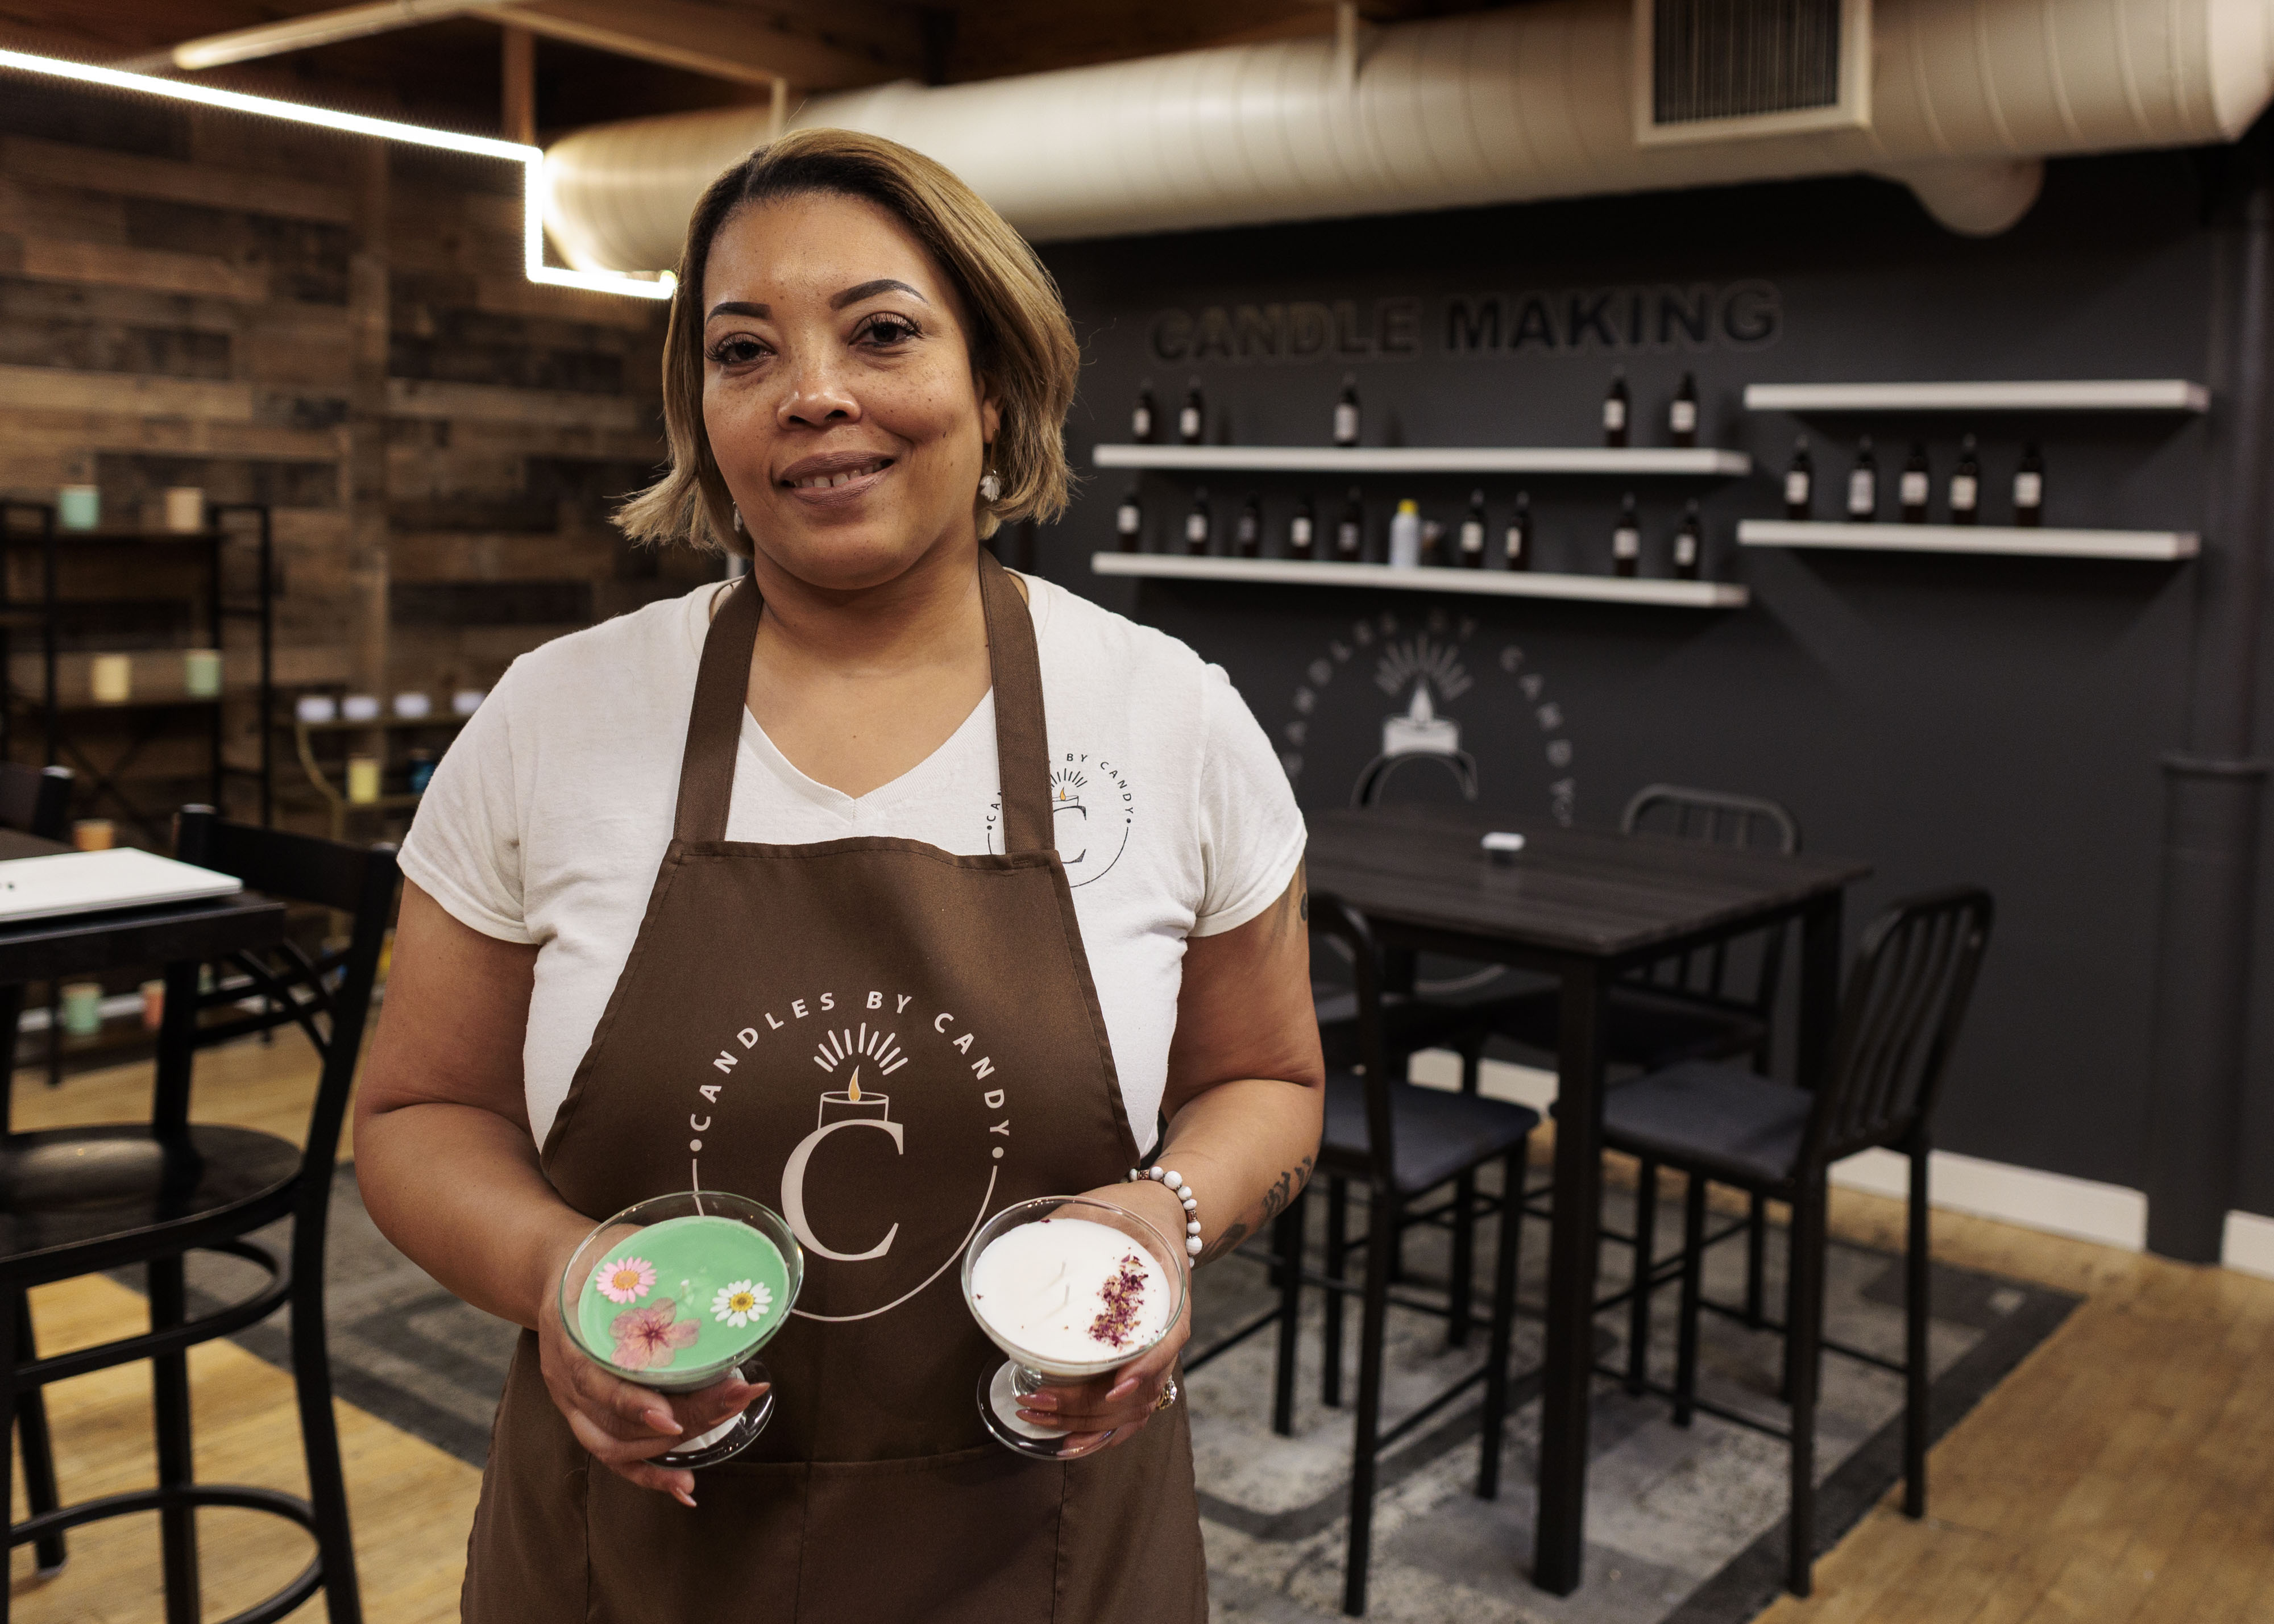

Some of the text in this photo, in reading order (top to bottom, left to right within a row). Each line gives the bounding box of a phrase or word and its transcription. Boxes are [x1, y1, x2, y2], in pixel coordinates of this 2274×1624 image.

[1150, 286, 1779, 363] CANDLE MAKING
[1067, 753, 1134, 815] BY CANDY
[690, 991, 1010, 1137] CANDLES BY CANDY
[781, 1119, 903, 1261] C
